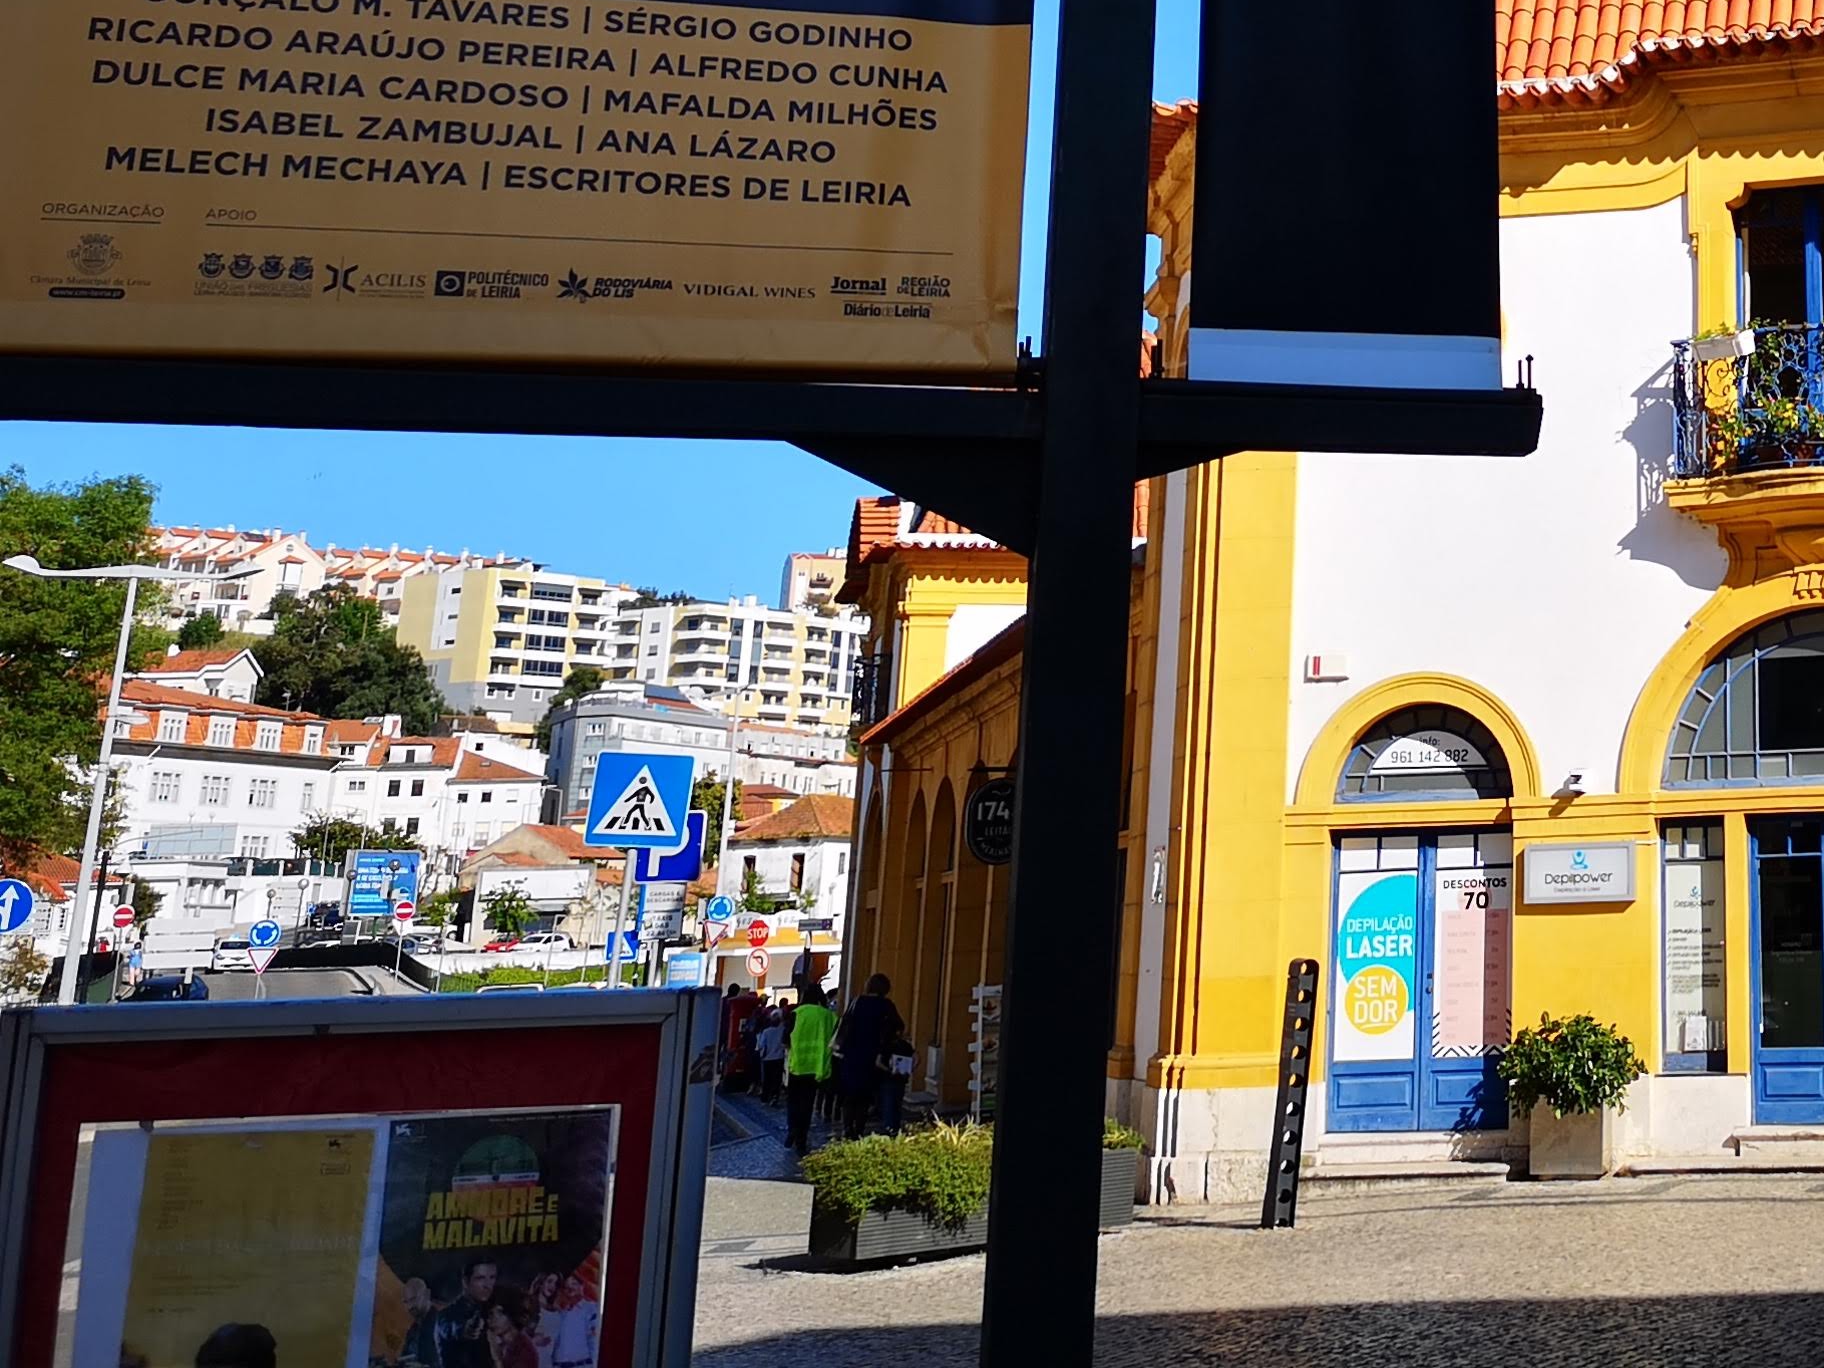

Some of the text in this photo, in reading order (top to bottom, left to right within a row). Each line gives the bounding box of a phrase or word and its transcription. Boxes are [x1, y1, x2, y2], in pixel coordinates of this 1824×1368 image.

[603, 7, 737, 41] SÉRGIO
[749, 20, 913, 51] GODINHO
[87, 16, 273, 51] RICARDO
[285, 29, 446, 62] ARAÚJO
[457, 40, 616, 73] PEREIRA
[649, 52, 817, 84] ALFREDO
[829, 63, 948, 94] CUNHA
[91, 60, 226, 91] DULCE
[238, 68, 366, 99] MARIA
[378, 76, 569, 109] CARDOSO
[603, 89, 776, 123] MAFALDA
[787, 98, 938, 131] MILHÕES
[205, 108, 345, 139] ISABEL
[357, 116, 563, 150] ZAMBUJAL
[596, 129, 677, 157] ANA
[688, 130, 837, 163] LÁZARO
[104, 145, 268, 178] MELECH
[281, 154, 468, 187] MECHAYA
[503, 165, 731, 199] ESCRITORES
[743, 177, 789, 202] DE
[800, 180, 912, 208] LEIRIA
[41, 202, 165, 219] ORGANIZAÇÃO
[205, 208, 257, 222] APOIO
[360, 274, 426, 289] ACILIS
[467, 269, 549, 287] POLITÉCNICO
[594, 276, 674, 291] RODOVIÁRIA
[830, 275, 886, 292] Jornal
[901, 275, 951, 289] REGIÃO
[481, 285, 521, 299] LEIRIA
[592, 287, 635, 299] DO LIS
[683, 283, 816, 300] VIDIGAL WINES
[910, 287, 951, 299] LEIRIA
[894, 305, 931, 319] Leiria
[1391, 749, 1469, 763] 961 142 882
[977, 801, 1010, 821] 174
[1443, 877, 1508, 890] DESCONTOS
[1346, 913, 1414, 934] DEPILAÇÃO
[747, 927, 769, 940] STOP
[1346, 934, 1414, 960] LASER
[1353, 974, 1398, 999] SEM
[1353, 999, 1399, 1025] DOR
[422, 1214, 559, 1251] MALAVITA
